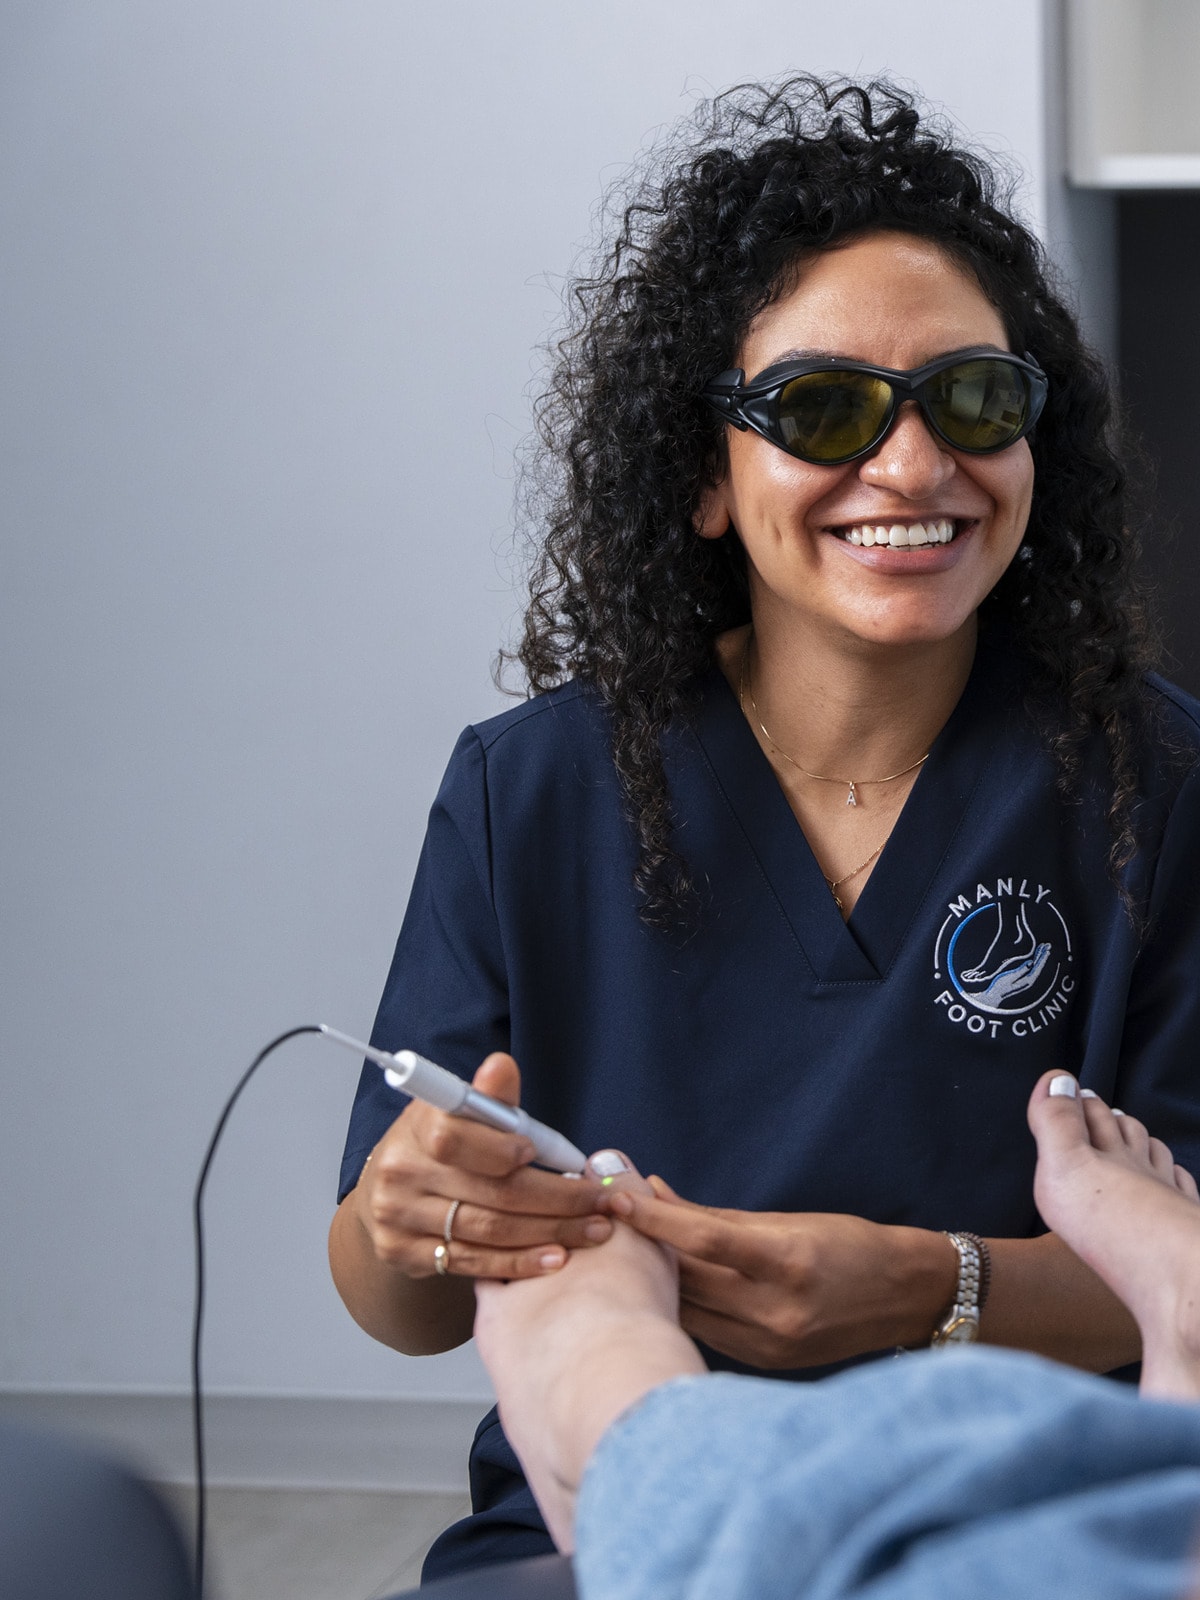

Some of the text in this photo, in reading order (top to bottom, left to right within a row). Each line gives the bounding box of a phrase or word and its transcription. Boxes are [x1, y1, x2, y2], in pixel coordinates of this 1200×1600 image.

[948, 877, 1051, 918] MANLY
[934, 975, 1075, 1038] FOOT CLINIC
